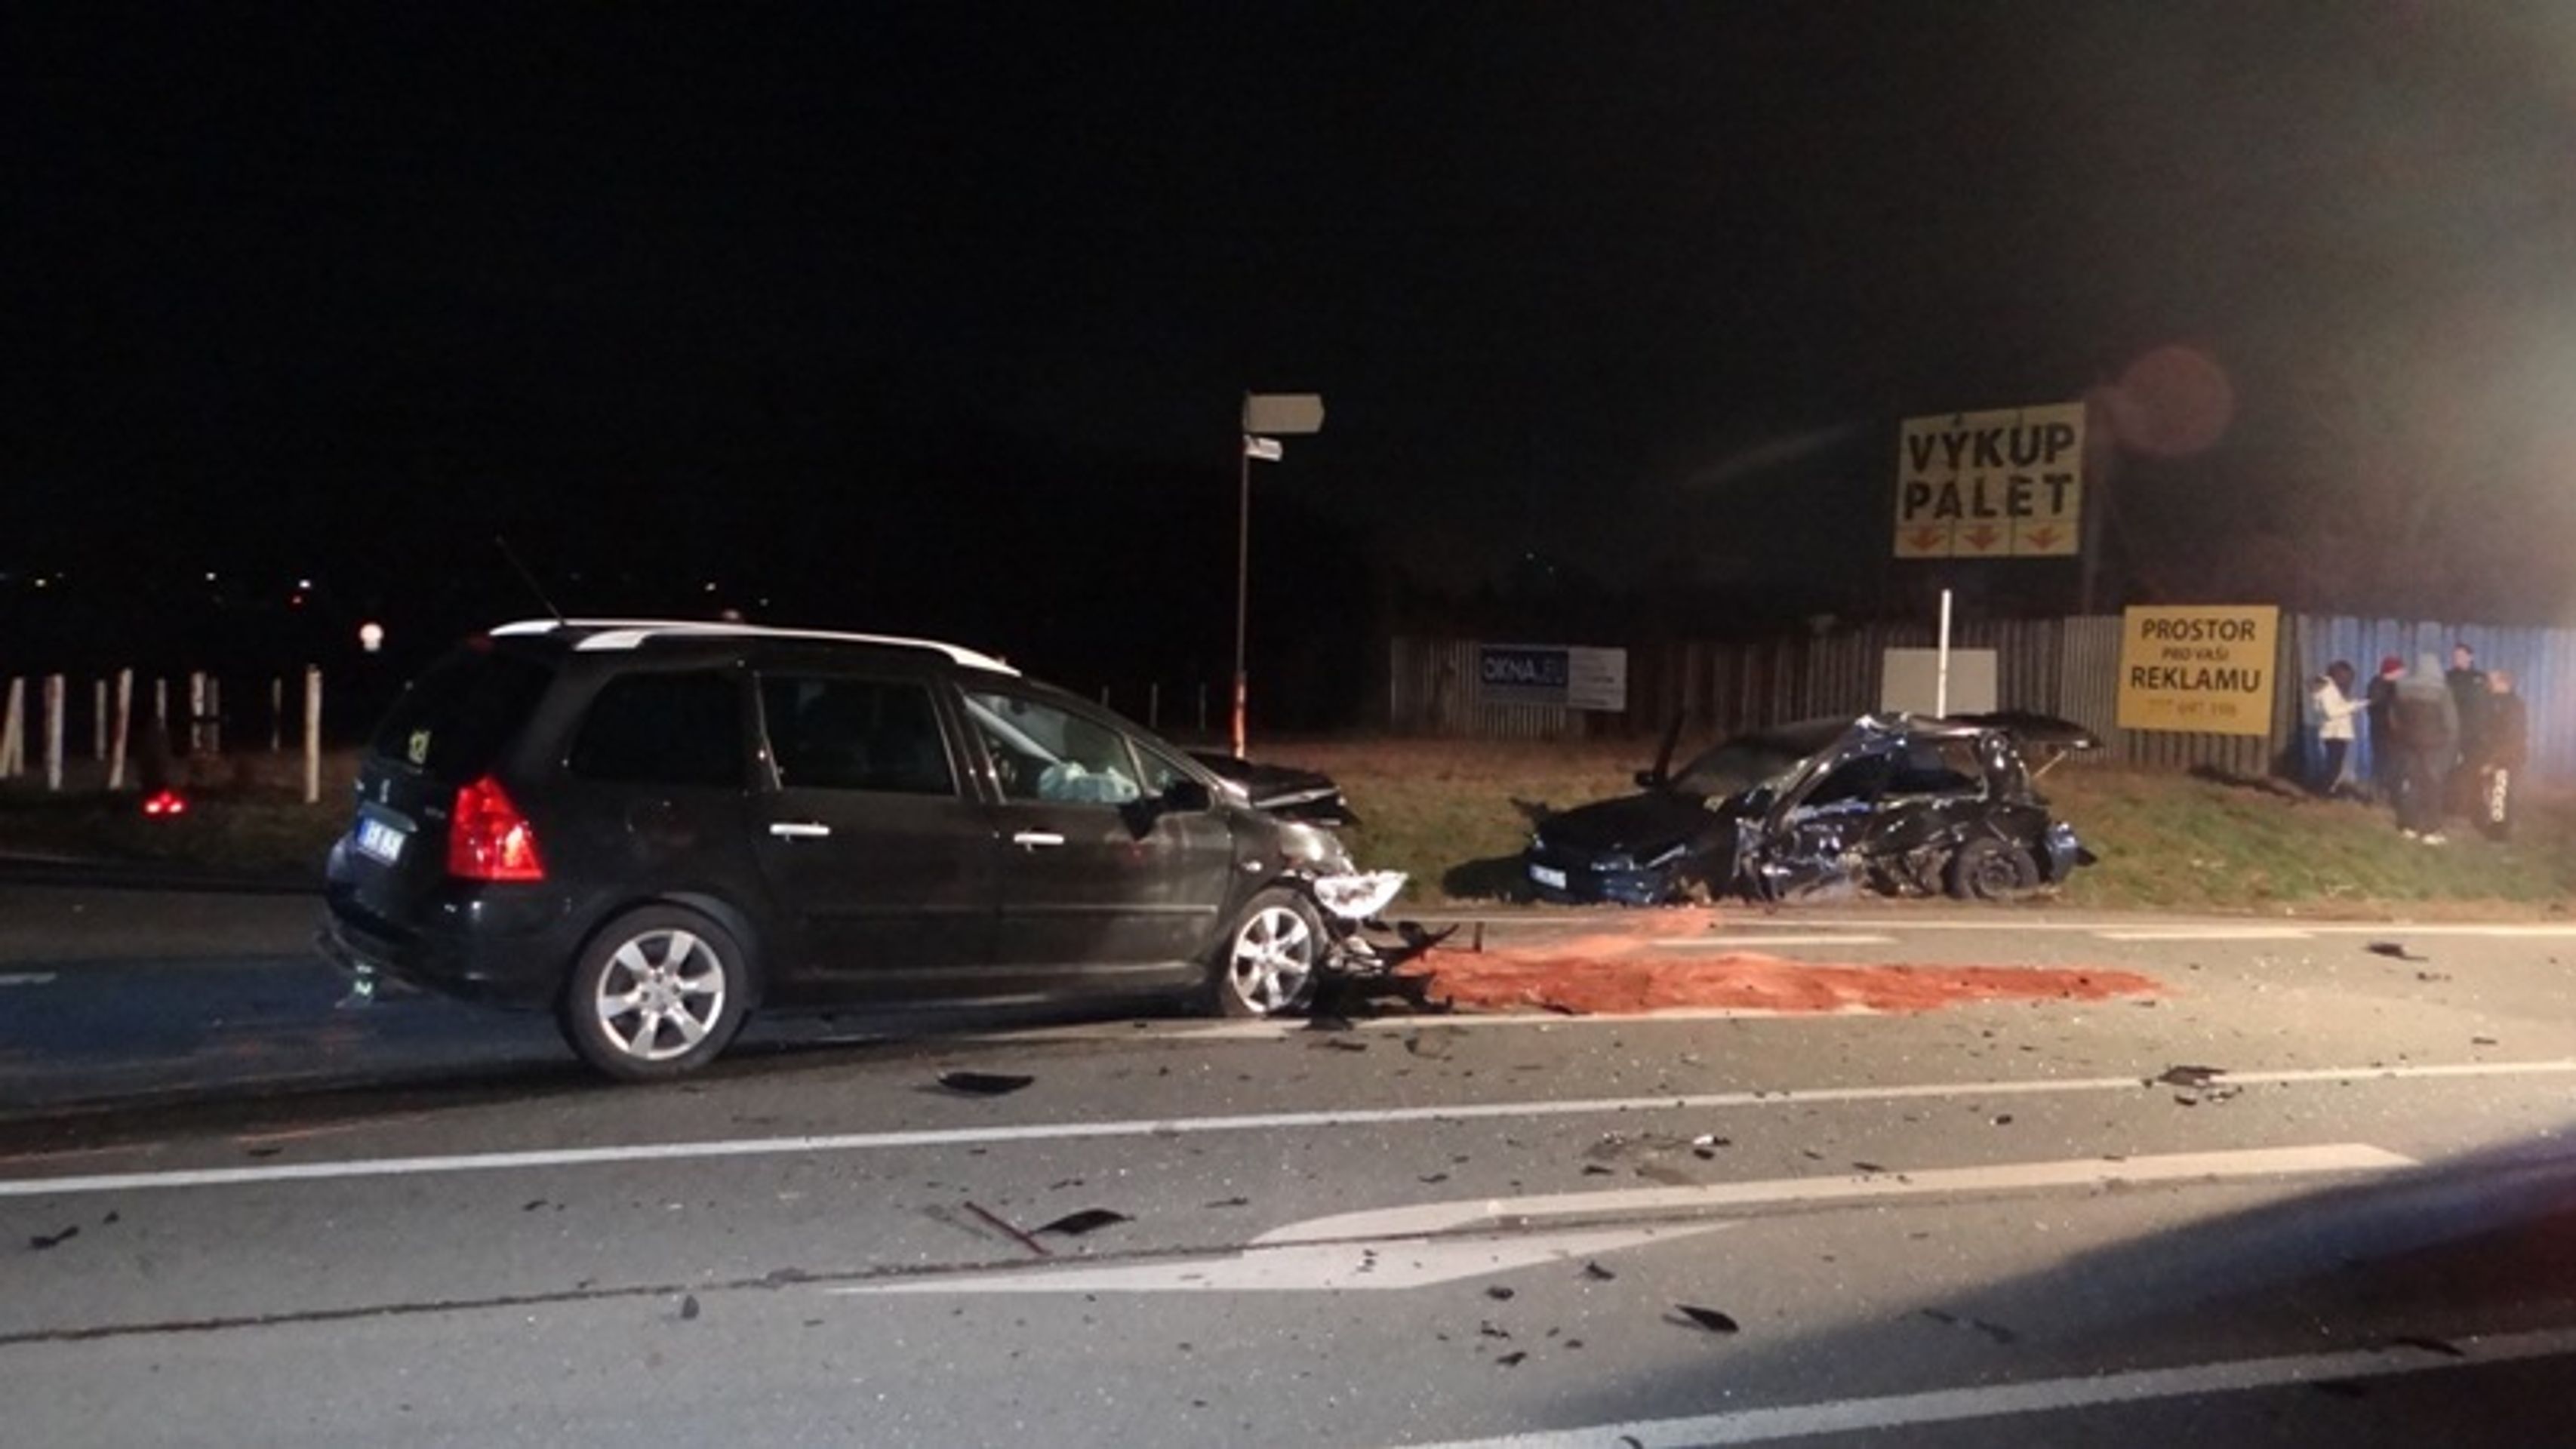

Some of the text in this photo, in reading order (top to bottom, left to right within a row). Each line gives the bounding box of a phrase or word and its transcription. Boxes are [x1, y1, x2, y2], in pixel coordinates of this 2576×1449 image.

[1904, 473, 2073, 520] PALET
[2141, 618, 2256, 641] PROSTOR
[2162, 648, 2191, 661] PRO
[2131, 666, 2261, 693] REKLAMU
